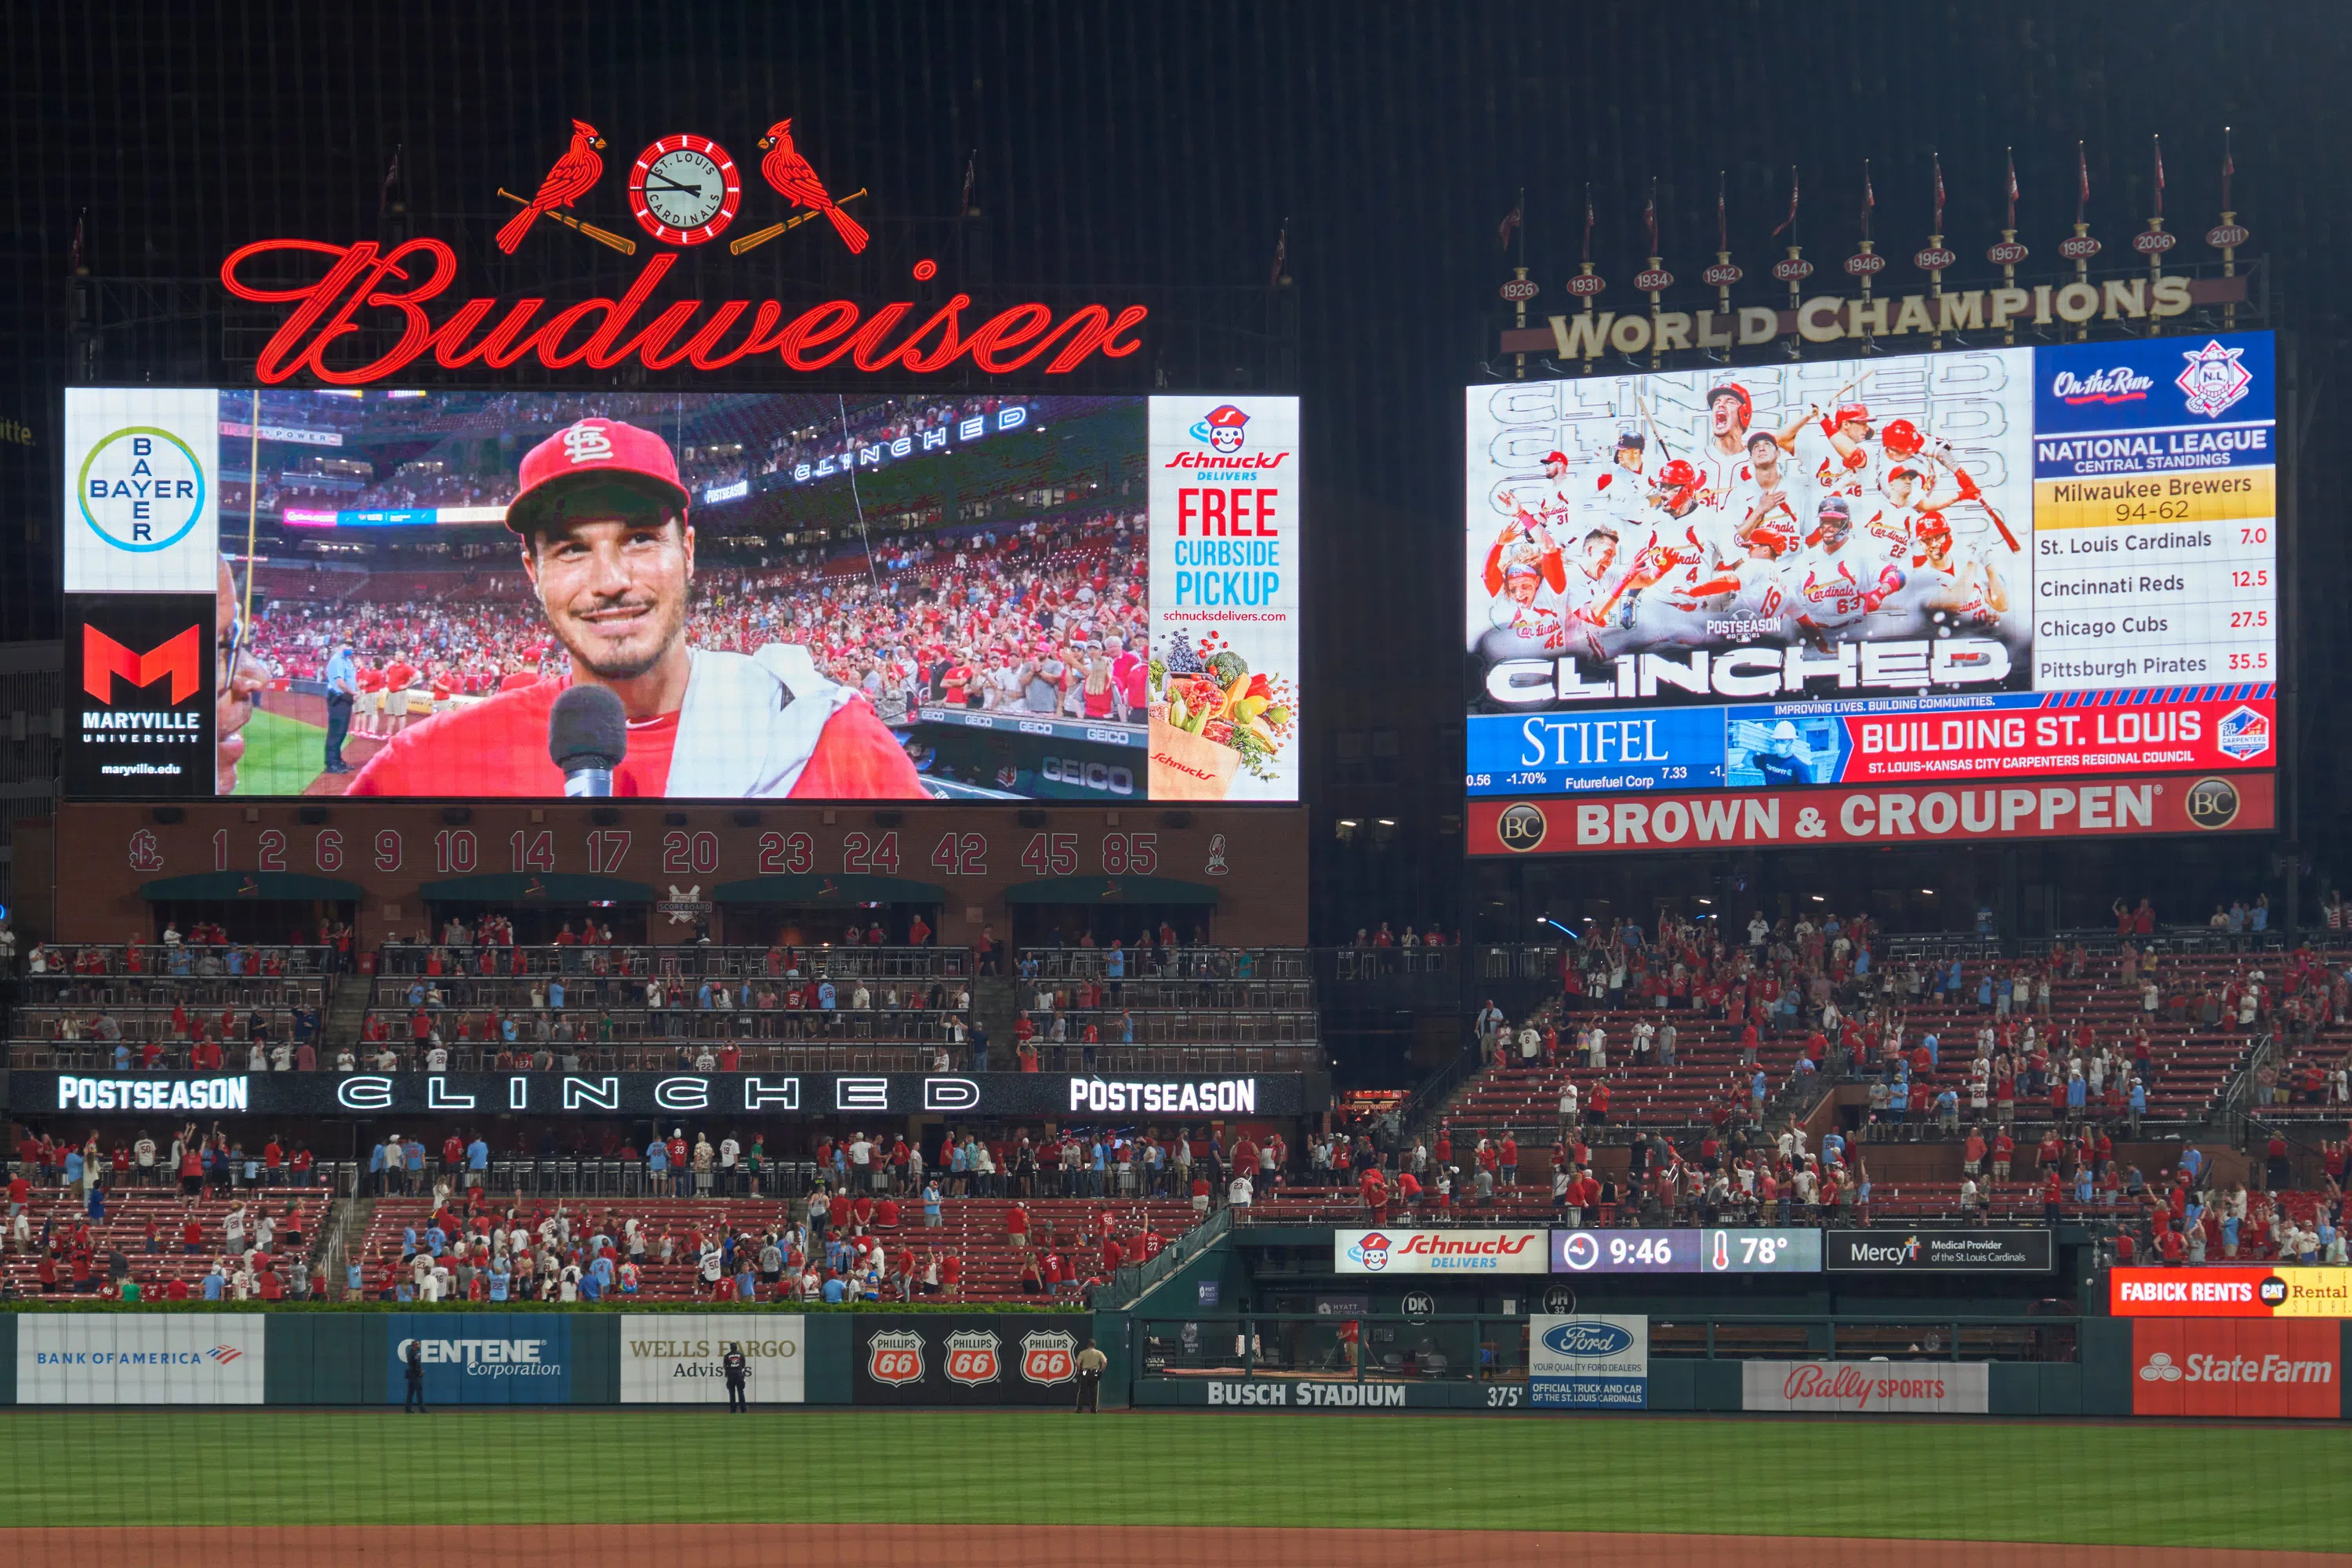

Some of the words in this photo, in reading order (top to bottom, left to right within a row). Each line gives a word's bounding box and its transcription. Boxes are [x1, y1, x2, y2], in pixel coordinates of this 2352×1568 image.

[654, 159, 673, 175] ST.
[675, 153, 715, 175] LOUIS
[649, 194, 720, 225] CARDINALS
[2137, 235, 2172, 249] 2006
[2211, 229, 2242, 244] 2011
[1991, 245, 2022, 260] 1967
[2063, 240, 2096, 255] 1982
[1848, 257, 1880, 271] 1946
[1918, 251, 1950, 266] 1964
[1706, 267, 1736, 282] 1942
[1776, 262, 1808, 278] 1944
[1571, 278, 1599, 292] 1931
[1637, 273, 1669, 288] 1934
[1503, 283, 1534, 298] 1926
[220, 238, 1148, 384] Budweiser
[1548, 306, 1779, 361] WORLD
[1796, 276, 2193, 343] CHAMPIONS
[793, 406, 1026, 482] CLINCHED
[2038, 436, 2163, 462] NATIONAL
[2169, 429, 2267, 455] LEAGUE
[1165, 452, 1290, 469] Schnucks
[2074, 458, 2143, 474] CENTRAL
[2145, 452, 2231, 470] STANDINGS
[1196, 471, 1258, 481] DELIVERS
[89, 479, 194, 499] BAYER
[2054, 481, 2161, 503] Milwaukee
[2169, 477, 2252, 496] Brewers
[1178, 488, 1279, 537] FREE
[2116, 499, 2189, 521] 94-62
[2040, 539, 2063, 555] St.
[2071, 535, 2119, 554] Louis
[2125, 530, 2212, 550] Cardinals
[2241, 528, 2267, 544] 7.0
[1175, 540, 1280, 566] CURBSIDE
[1176, 571, 1280, 606] PICKUP
[2040, 576, 2133, 597] Cincinnati
[2140, 575, 2185, 592] Reds
[2232, 571, 2268, 587] 12.5
[1163, 610, 1287, 622] schnucksdelivers.com
[1707, 615, 1781, 635] POSTSEASON
[2040, 618, 2116, 637] Chicago
[2122, 615, 2169, 633] Cubs
[2230, 611, 2268, 628] 27.5
[1486, 638, 2013, 704] CLINCHED
[2040, 658, 2137, 678] Pittsburgh
[2143, 655, 2207, 673] Pirates
[2228, 652, 2268, 670] 35.5
[1774, 702, 1832, 715] IMPROVING
[1834, 701, 1866, 713] LIVES.
[1868, 699, 1918, 711] BUILDING
[1919, 696, 1996, 710] COMMUNITIES.
[82, 712, 200, 729] MARYVILLE
[82, 734, 198, 743] UNIVERSITY
[1087, 728, 1130, 745] GEICO
[1862, 717, 2026, 753] BUILDING
[2036, 715, 2086, 746] ST.
[2098, 710, 2201, 745] LOUIS
[1521, 716, 1668, 767] STIFEL
[101, 764, 182, 776] maryville.edu
[1149, 752, 1217, 780] Schnucks
[1868, 761, 1886, 774] ST.
[1888, 758, 1973, 773] LOUIS-KANSAS
[1975, 757, 2001, 770] CITY
[2003, 754, 2080, 768] CARPENTERS
[2082, 753, 2140, 766] REGIONAL
[2143, 750, 2194, 763] COUNCIL
[1042, 757, 1133, 795] GEICO
[1506, 772, 1547, 785] -1.70%
[1566, 775, 1623, 789] Futurefuel
[1625, 775, 1654, 789] Corp
[1661, 767, 1688, 779] 7.33
[1504, 816, 1541, 839] BC
[1577, 798, 1780, 845] BROWN
[1794, 807, 1827, 838] &
[212, 829, 227, 871] 1
[259, 829, 286, 872] 2
[316, 829, 343, 871] 6
[375, 829, 401, 871] 9
[434, 830, 477, 873] 10
[510, 830, 555, 873] 14
[586, 830, 631, 873] 17
[663, 831, 719, 873] 20
[759, 832, 814, 874] 23
[844, 832, 899, 874] 24
[931, 833, 987, 875] 42
[1021, 833, 1079, 875] 45
[1102, 833, 1158, 875] 85
[59, 1076, 248, 1111] POSTSEASON
[338, 1076, 979, 1109] CLINCHED
[1070, 1077, 1255, 1112] POSTSEASON
[1398, 1235, 1535, 1254] Schnucks
[1610, 1237, 1672, 1265] 9:46
[1740, 1236, 1788, 1265] 78°
[1851, 1243, 1907, 1265] Mercy
[1931, 1240, 1965, 1250] Medical
[1967, 1240, 2002, 1250] Provider
[1431, 1258, 1497, 1268] DELIVERS
[1931, 1253, 1940, 1262] of
[1940, 1253, 1955, 1262] the
[1955, 1253, 1965, 1262] St.
[1965, 1253, 1987, 1262] Louis
[1987, 1252, 2026, 1262] Cardinals
[1550, 1292, 1568, 1305] JH
[2121, 1283, 2187, 1301] FABICK
[2191, 1283, 2252, 1302] RENTS
[2261, 1284, 2285, 1299] CAT
[2292, 1285, 2348, 1298] Rental
[1408, 1297, 1428, 1312] DK
[1554, 1305, 1566, 1315] 32
[877, 1338, 916, 1348] PHILLIPS
[953, 1338, 992, 1348] PHILLIPS
[1559, 1327, 1615, 1351] Ford
[37, 1352, 86, 1365] BANK
[92, 1352, 114, 1365] OF
[119, 1352, 201, 1365] AMERICA
[630, 1340, 710, 1358] WELLS
[466, 1361, 561, 1379] Corporation
[673, 1362, 752, 1377] Adviss
[880, 1354, 913, 1374] 66
[955, 1354, 989, 1374] 66
[1533, 1363, 1554, 1372] YOUR
[1555, 1363, 1586, 1373] QUALITY
[1587, 1363, 1607, 1372] FORD
[1609, 1363, 1642, 1372] DEALERS
[1207, 1381, 1287, 1405] BUSCH
[1296, 1382, 1406, 1406] STADIUM
[1533, 1383, 1572, 1393] OFFICIAL
[1573, 1384, 1602, 1393] TRUCK
[1604, 1385, 1623, 1393] AND
[1624, 1385, 1642, 1394] CAR
[1784, 1363, 1875, 1409] Bally
[1878, 1379, 1945, 1399] SPORTS
[1487, 1386, 1523, 1407] 375'
[1532, 1393, 1544, 1402] OF
[1544, 1393, 1560, 1402] THE
[1560, 1394, 1573, 1403] ST.
[1573, 1394, 1597, 1403] LOUIS
[1598, 1394, 1642, 1403] CARDINALS
